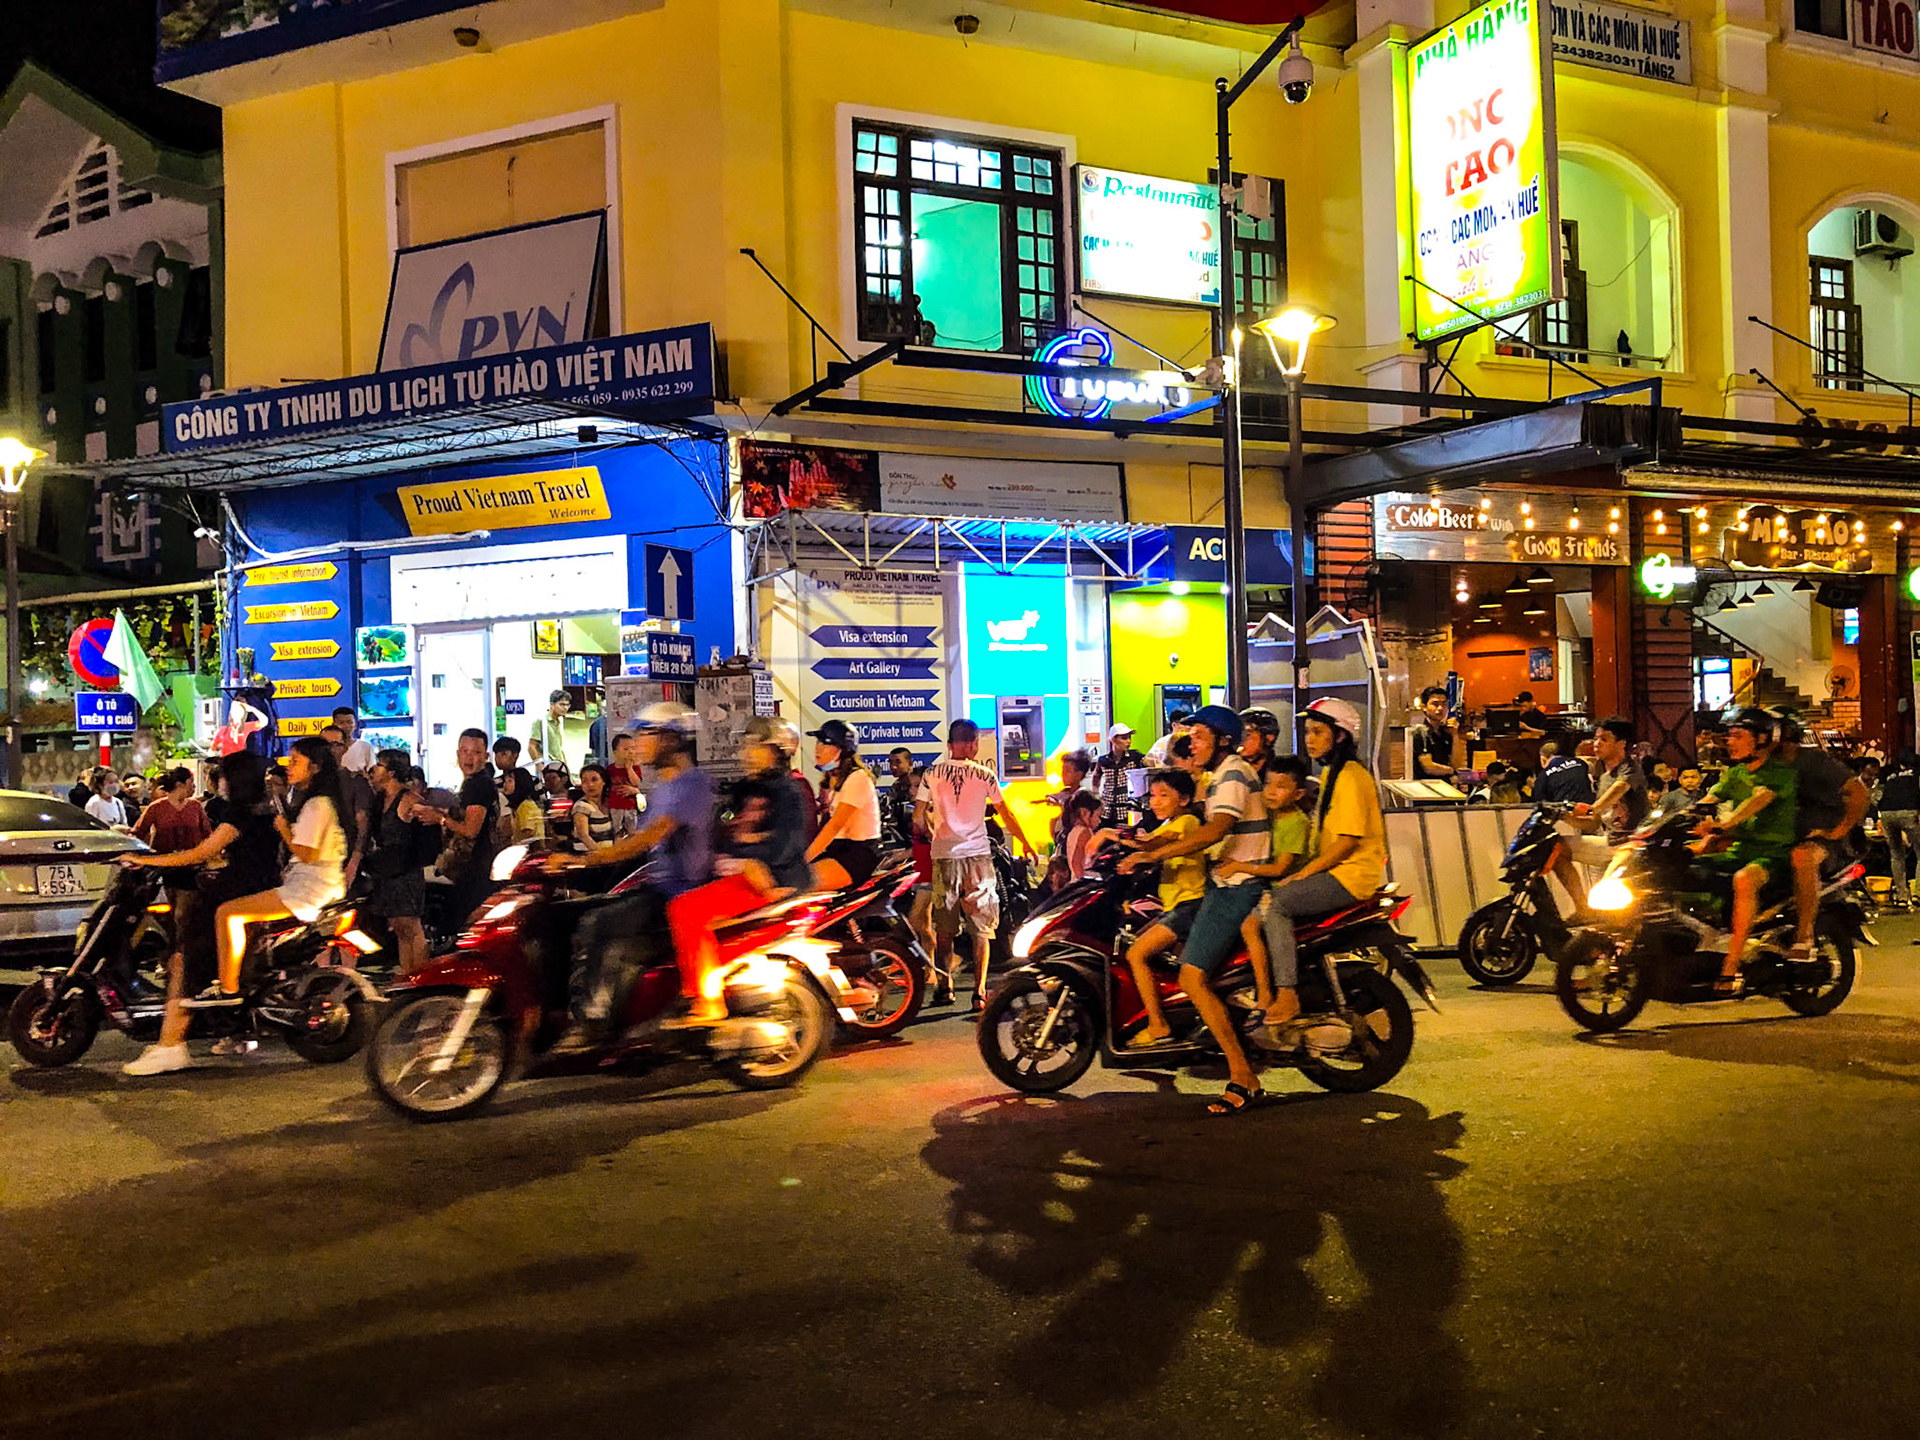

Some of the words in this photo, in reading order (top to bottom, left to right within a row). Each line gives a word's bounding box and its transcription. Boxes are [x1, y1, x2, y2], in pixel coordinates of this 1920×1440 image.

[1570, 3, 1586, 41] VÀ
[1588, 7, 1610, 46] CÁC
[1613, 12, 1639, 52] MÓN
[1659, 20, 1680, 60] HUẾ
[1552, 42, 1636, 68] 2343823031
[458, 301, 570, 360] PVN
[175, 405, 239, 441] CÔNG
[244, 401, 271, 432] TY
[278, 391, 342, 427] TNHH
[348, 384, 382, 418] DU
[390, 374, 446, 417] LỊCH
[453, 364, 488, 405] TỰ
[493, 356, 548, 396] HÀO
[556, 346, 615, 391] VIỆT
[624, 338, 693, 379] NAM
[592, 391, 612, 404] 059
[622, 388, 648, 402] 0935
[650, 384, 671, 396] 622
[674, 381, 694, 394] 299
[412, 490, 463, 515] Proud
[463, 485, 535, 510] Vietnam
[534, 477, 591, 503] Travel
[549, 506, 597, 519] Welcome
[1395, 505, 1434, 527] Cold
[1438, 507, 1475, 529] Beer
[1490, 518, 1514, 532] With
[1189, 537, 1226, 561] AC
[1523, 535, 1561, 557] Good
[1564, 536, 1617, 558] Friends
[1780, 548, 1798, 560] Bar
[844, 570, 872, 581] PROUD
[875, 571, 909, 582] VIETNAM
[912, 573, 941, 583] TRAVEL
[254, 607, 287, 620] Excursion
[300, 604, 328, 616] Vietnam
[839, 630, 860, 643] Visa
[862, 630, 908, 643] extension
[278, 645, 293, 656] Visa
[298, 644, 332, 655] extension
[669, 641, 692, 657] KHÁCH
[651, 657, 670, 674] TRÊN
[670, 662, 680, 675] 29
[849, 661, 864, 674] Art
[866, 661, 901, 676] Gallery
[279, 683, 307, 695] Private
[311, 683, 332, 693] tours
[96, 698, 104, 711] Ô
[104, 698, 117, 711] TÔ
[506, 702, 523, 712] OPEN
[829, 694, 875, 708] Excursion
[876, 694, 887, 707] in
[887, 694, 925, 707] Vietnam
[80, 712, 105, 725] TRÊN
[288, 721, 307, 734] Daily
[855, 726, 900, 741] SIC/private
[902, 725, 924, 737] tours
[49, 866, 74, 880] 75A
